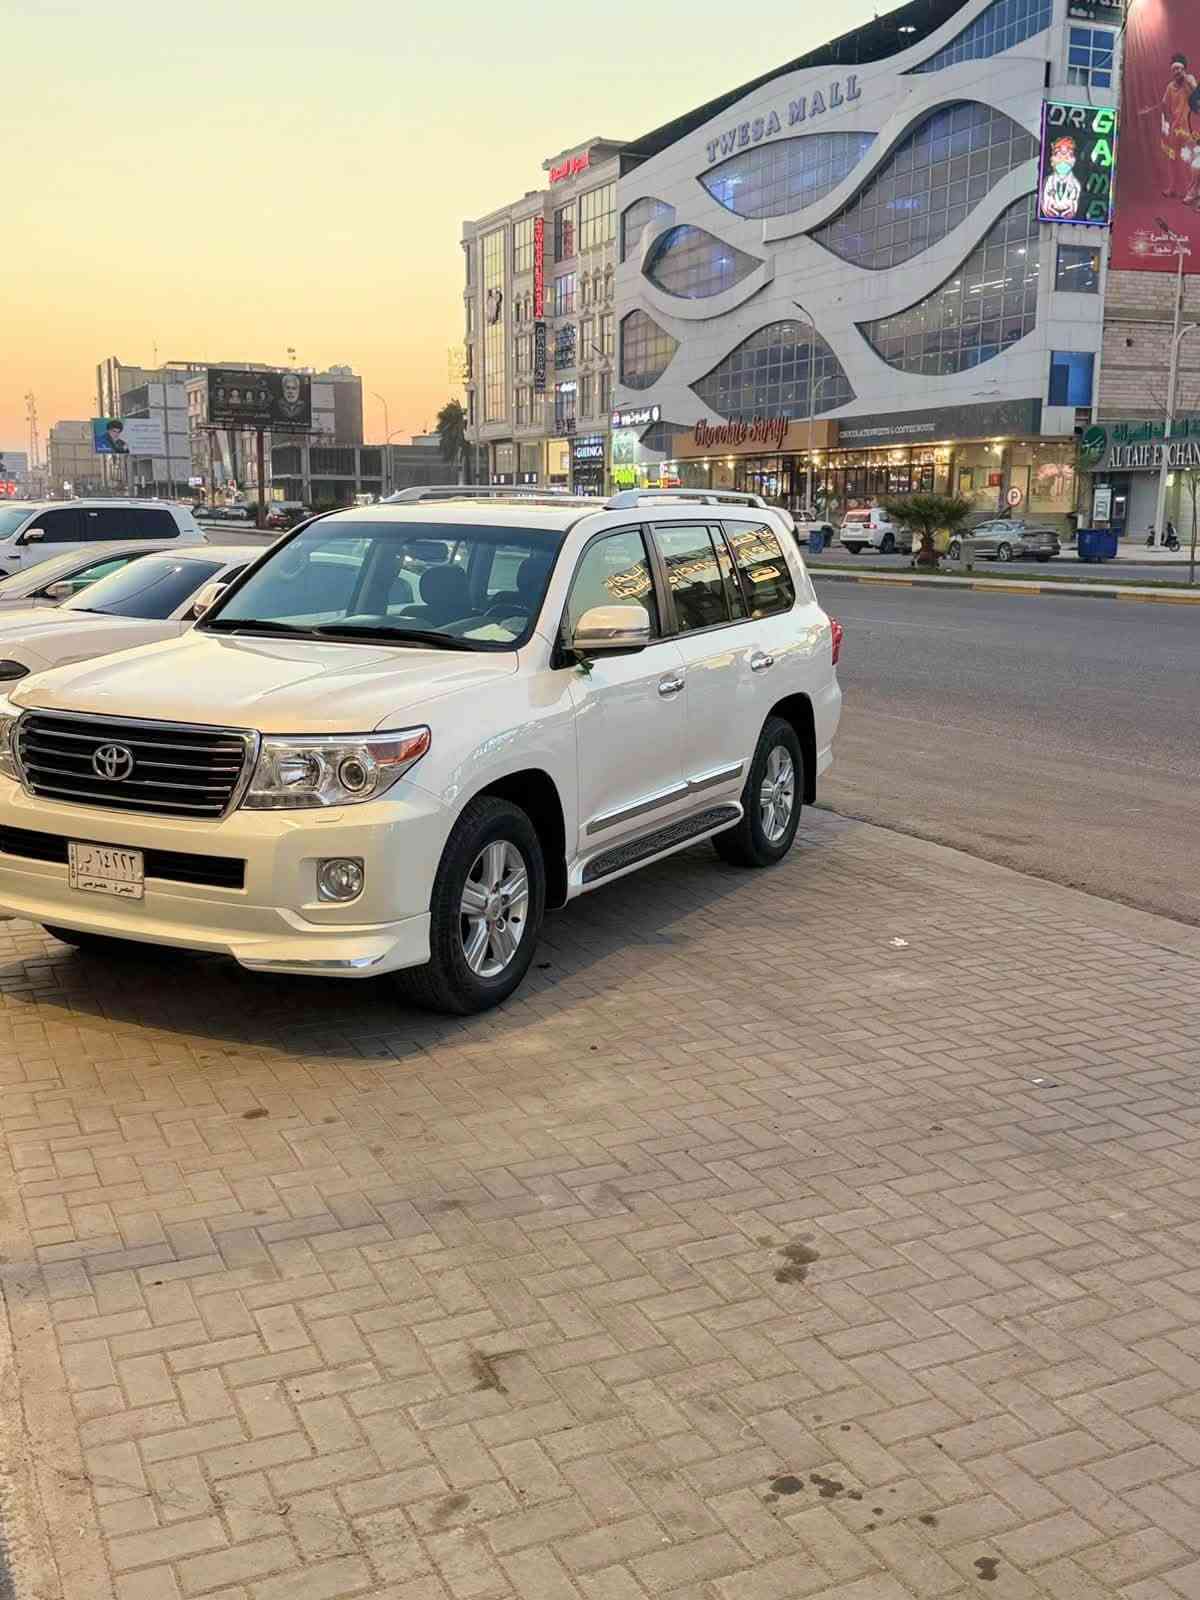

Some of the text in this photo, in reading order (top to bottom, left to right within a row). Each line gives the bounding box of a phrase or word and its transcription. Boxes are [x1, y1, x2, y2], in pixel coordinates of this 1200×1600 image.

[706, 75, 862, 163] TWESA MALL
[1047, 105, 1086, 128] DR.
[1107, 441, 1200, 468] AL TAIF ECHAN
